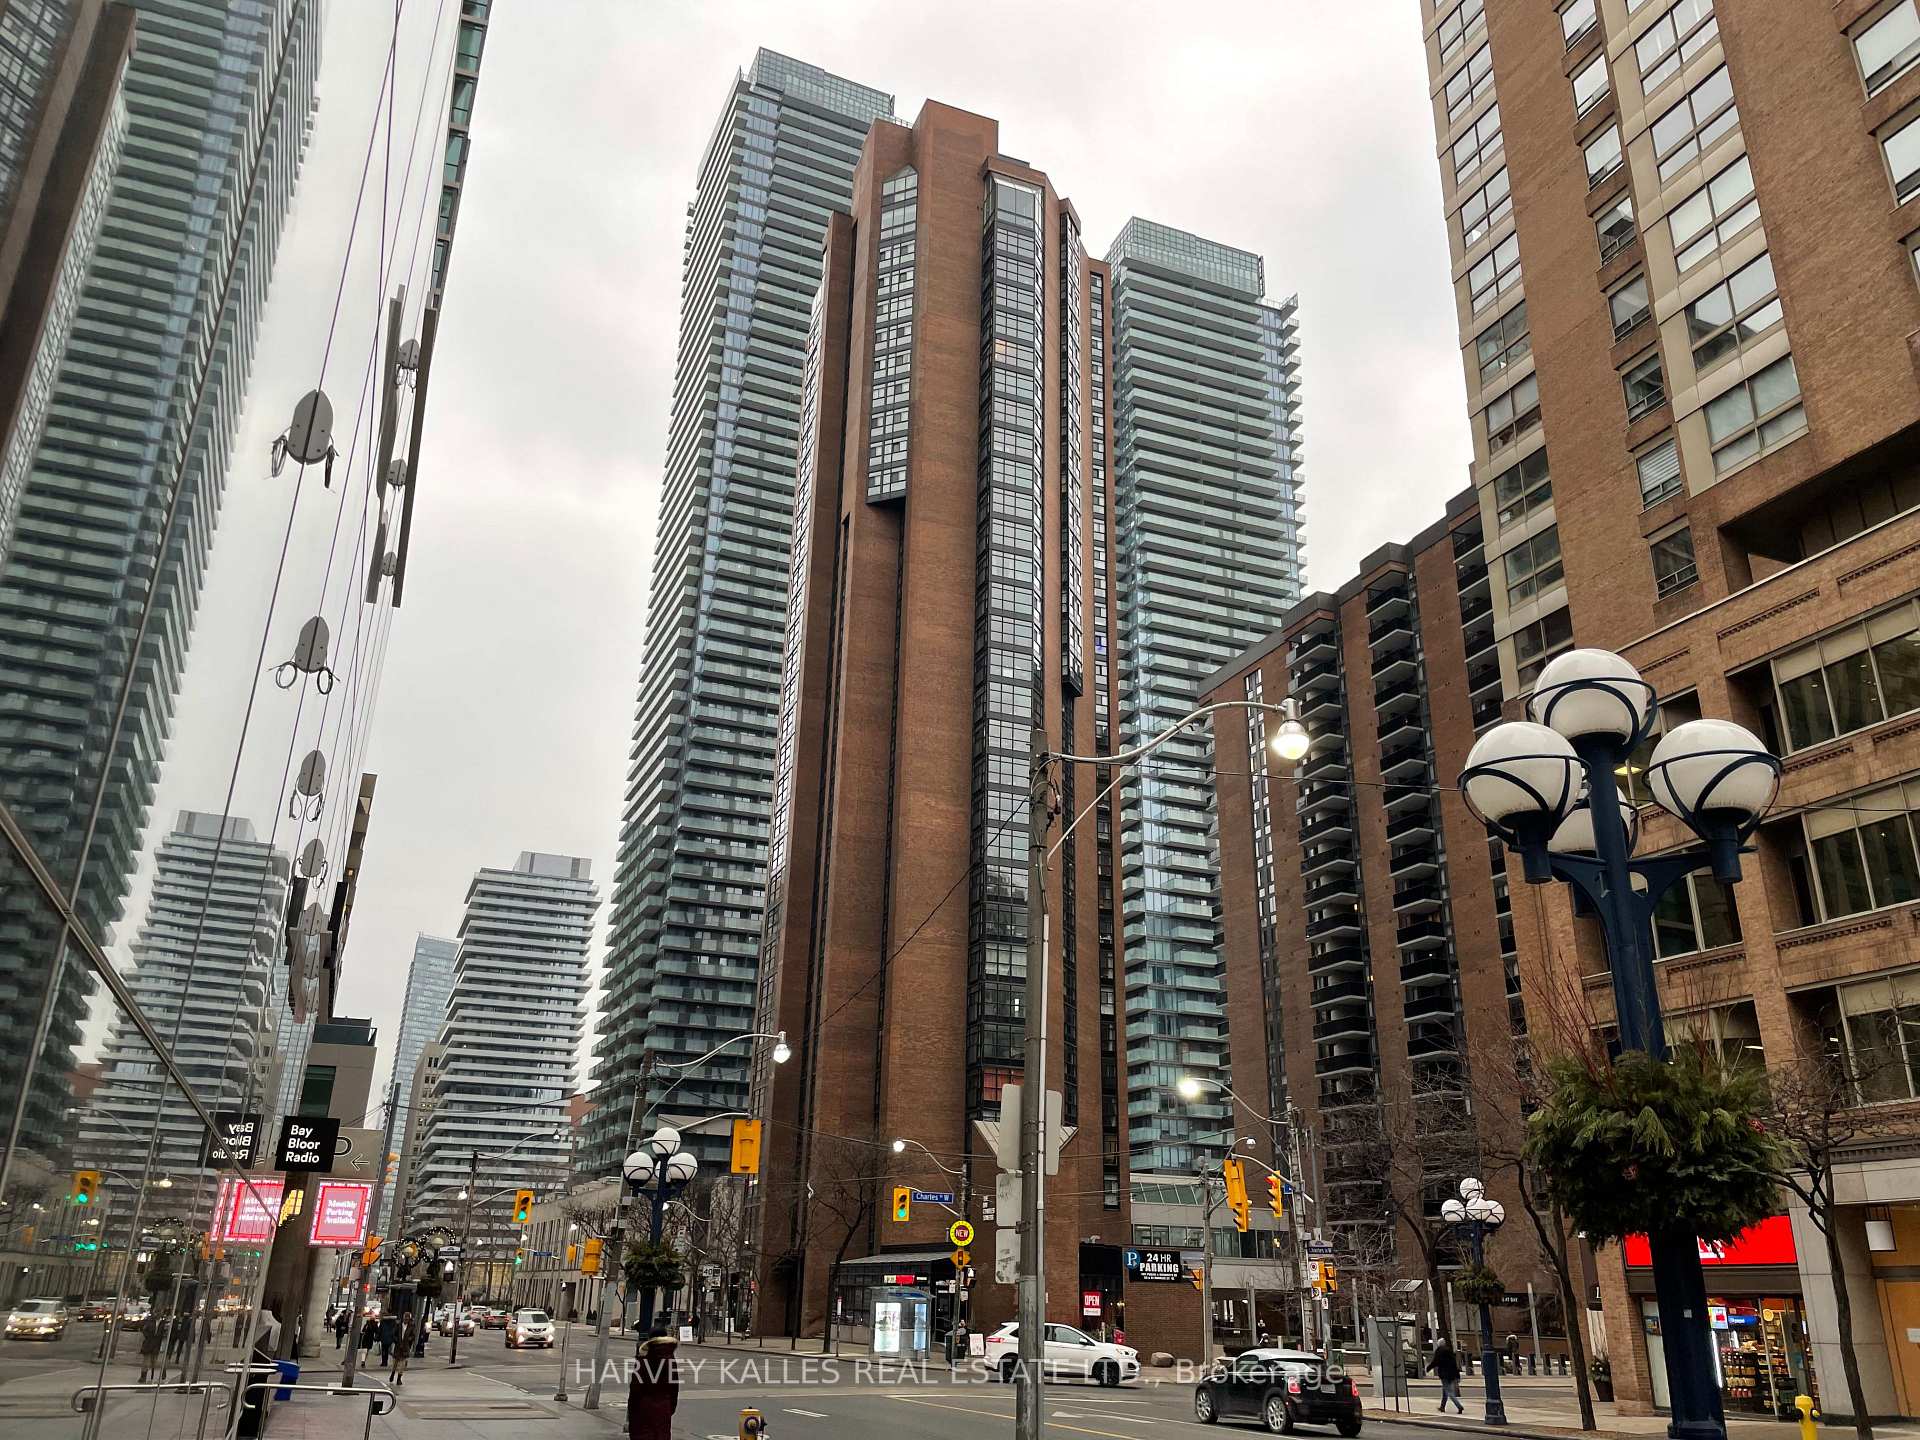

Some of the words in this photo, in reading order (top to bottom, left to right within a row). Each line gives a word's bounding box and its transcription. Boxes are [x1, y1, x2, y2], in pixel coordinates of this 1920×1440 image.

[290, 1124, 314, 1138] Bay
[287, 1138, 321, 1151] Bloor
[285, 1151, 321, 1164] Radio
[916, 1192, 939, 1202] Charles
[955, 1229, 969, 1238] NEW
[1146, 1253, 1159, 1263] 24
[1160, 1253, 1172, 1263] HR
[1139, 1262, 1180, 1273] PARKING
[1084, 1295, 1100, 1307] OPEN
